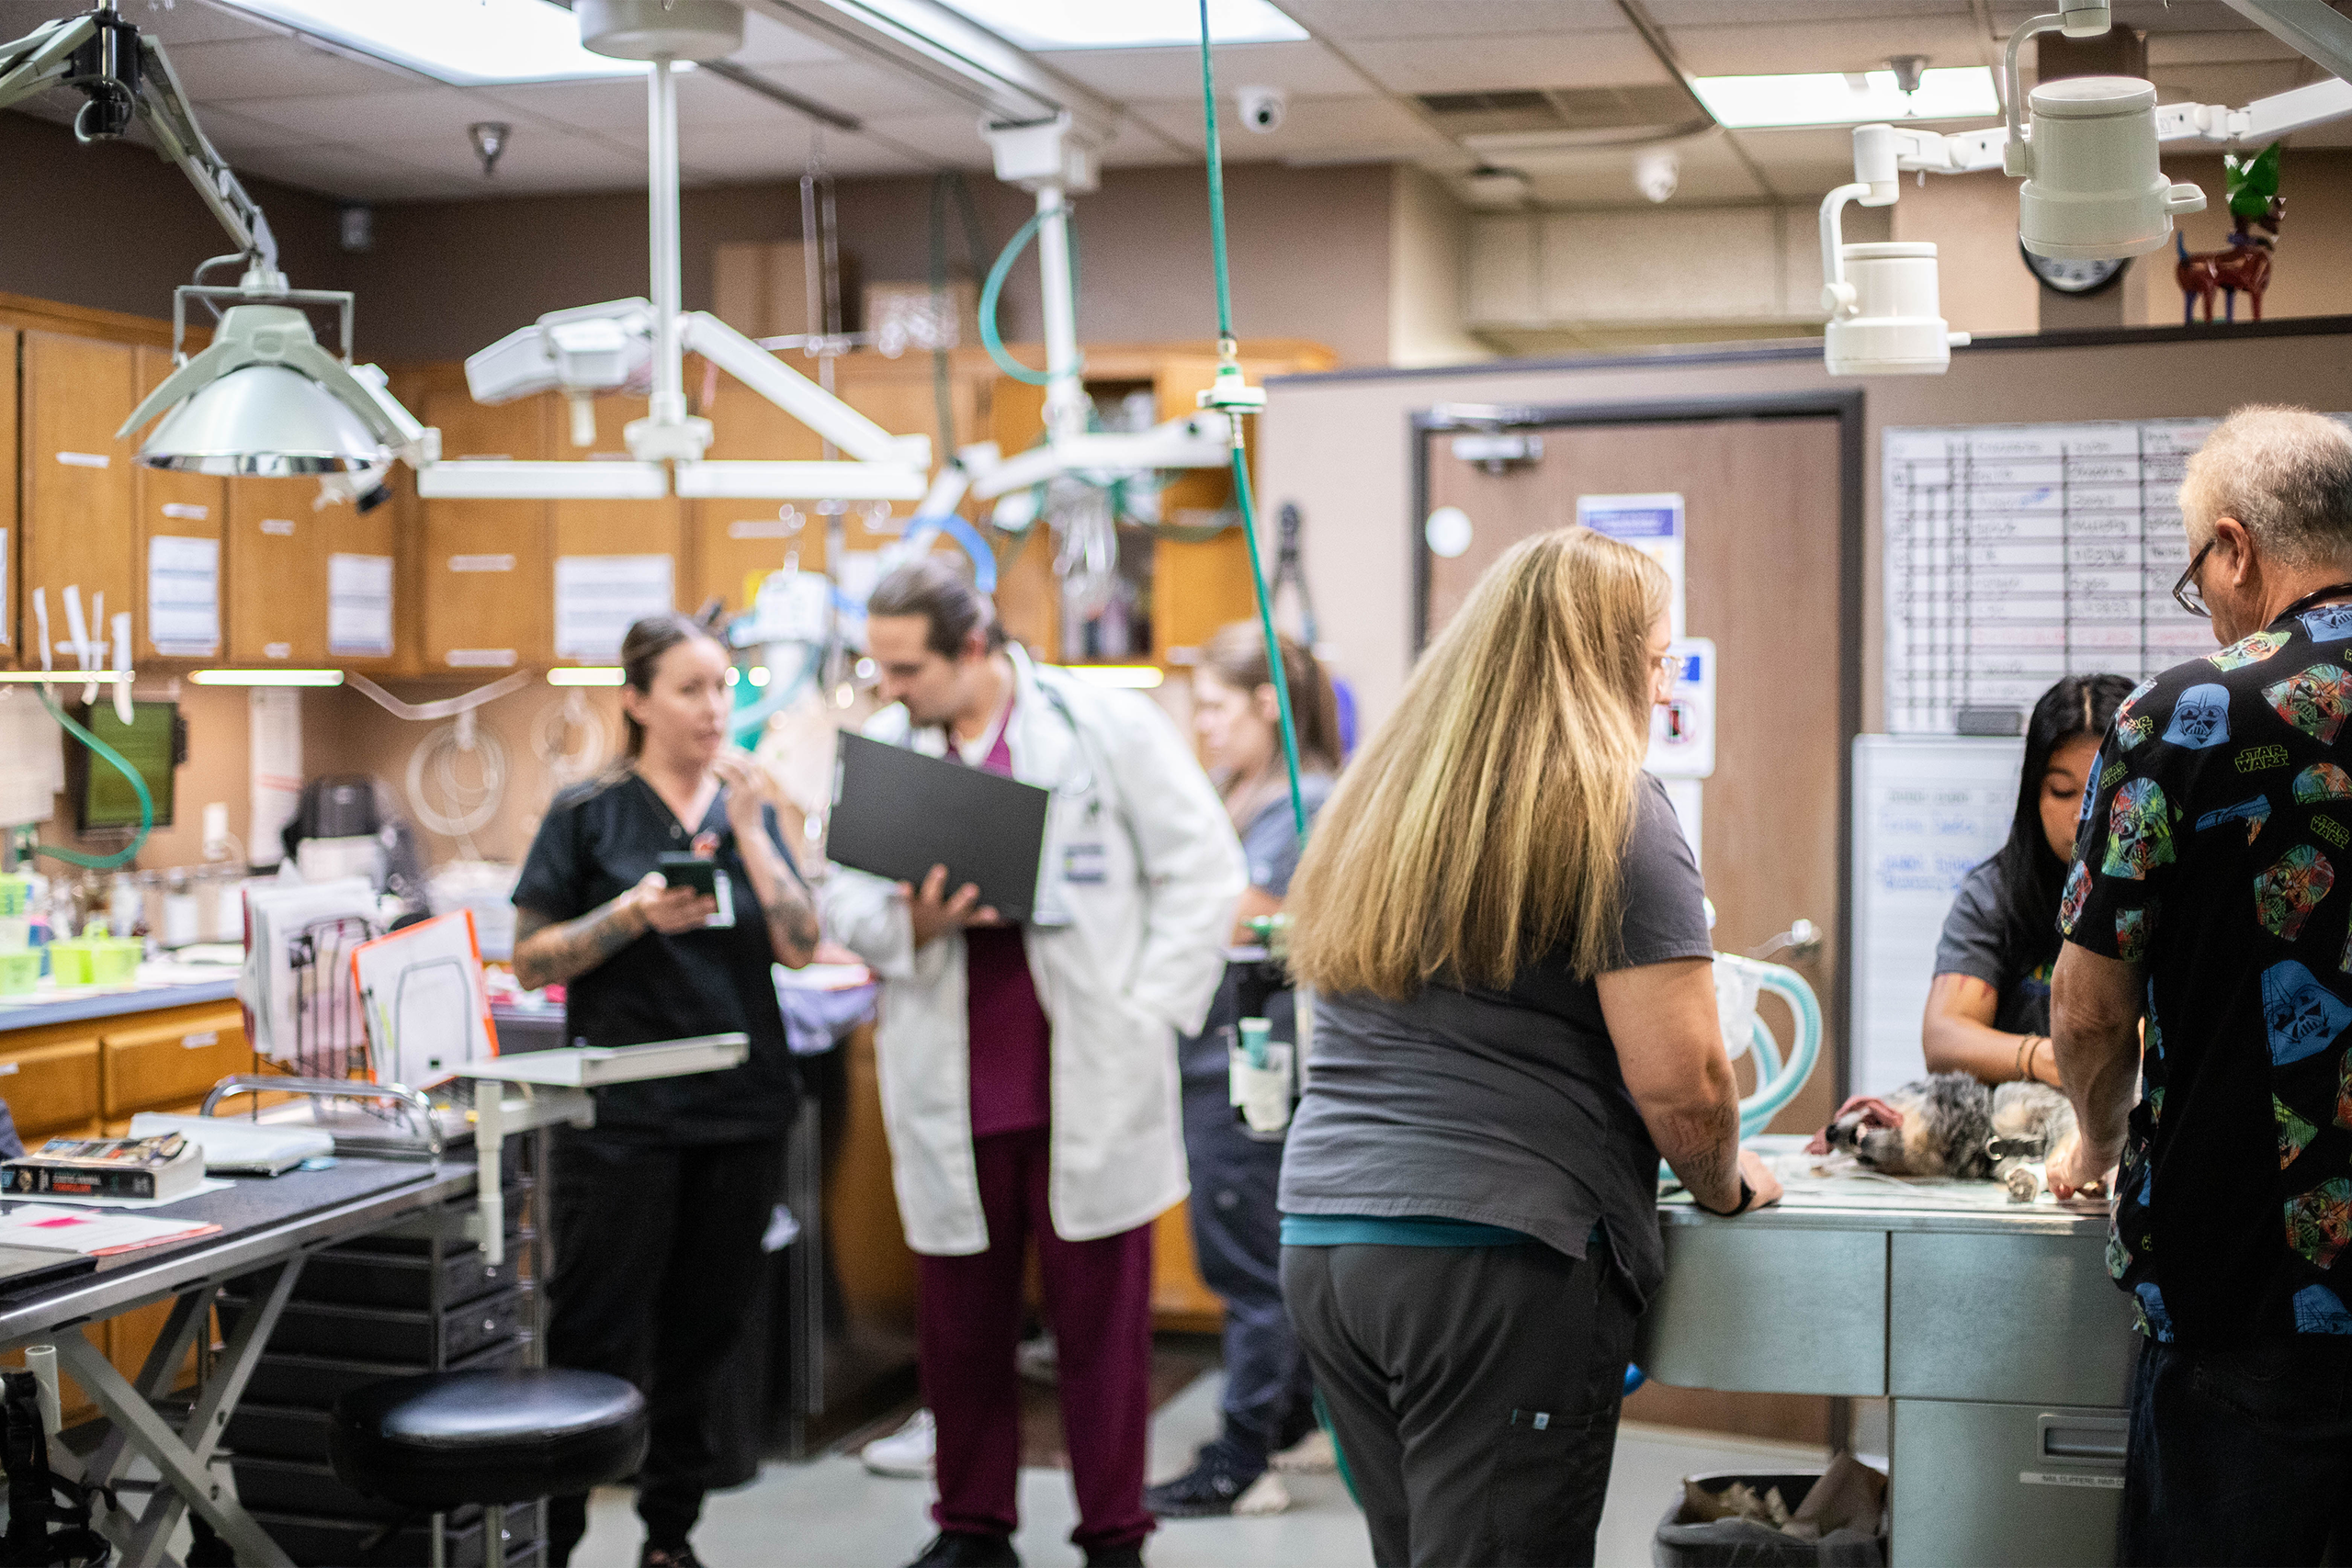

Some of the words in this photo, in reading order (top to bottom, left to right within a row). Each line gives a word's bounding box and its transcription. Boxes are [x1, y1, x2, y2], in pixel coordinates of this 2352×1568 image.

[2235, 745, 2288, 761] STAR
[2103, 761, 2126, 781] STAR
[2234, 756, 2286, 773] WARS
[2101, 770, 2125, 790] WARS
[2311, 818, 2343, 847] WARS
[2313, 815, 2349, 844] STAR
